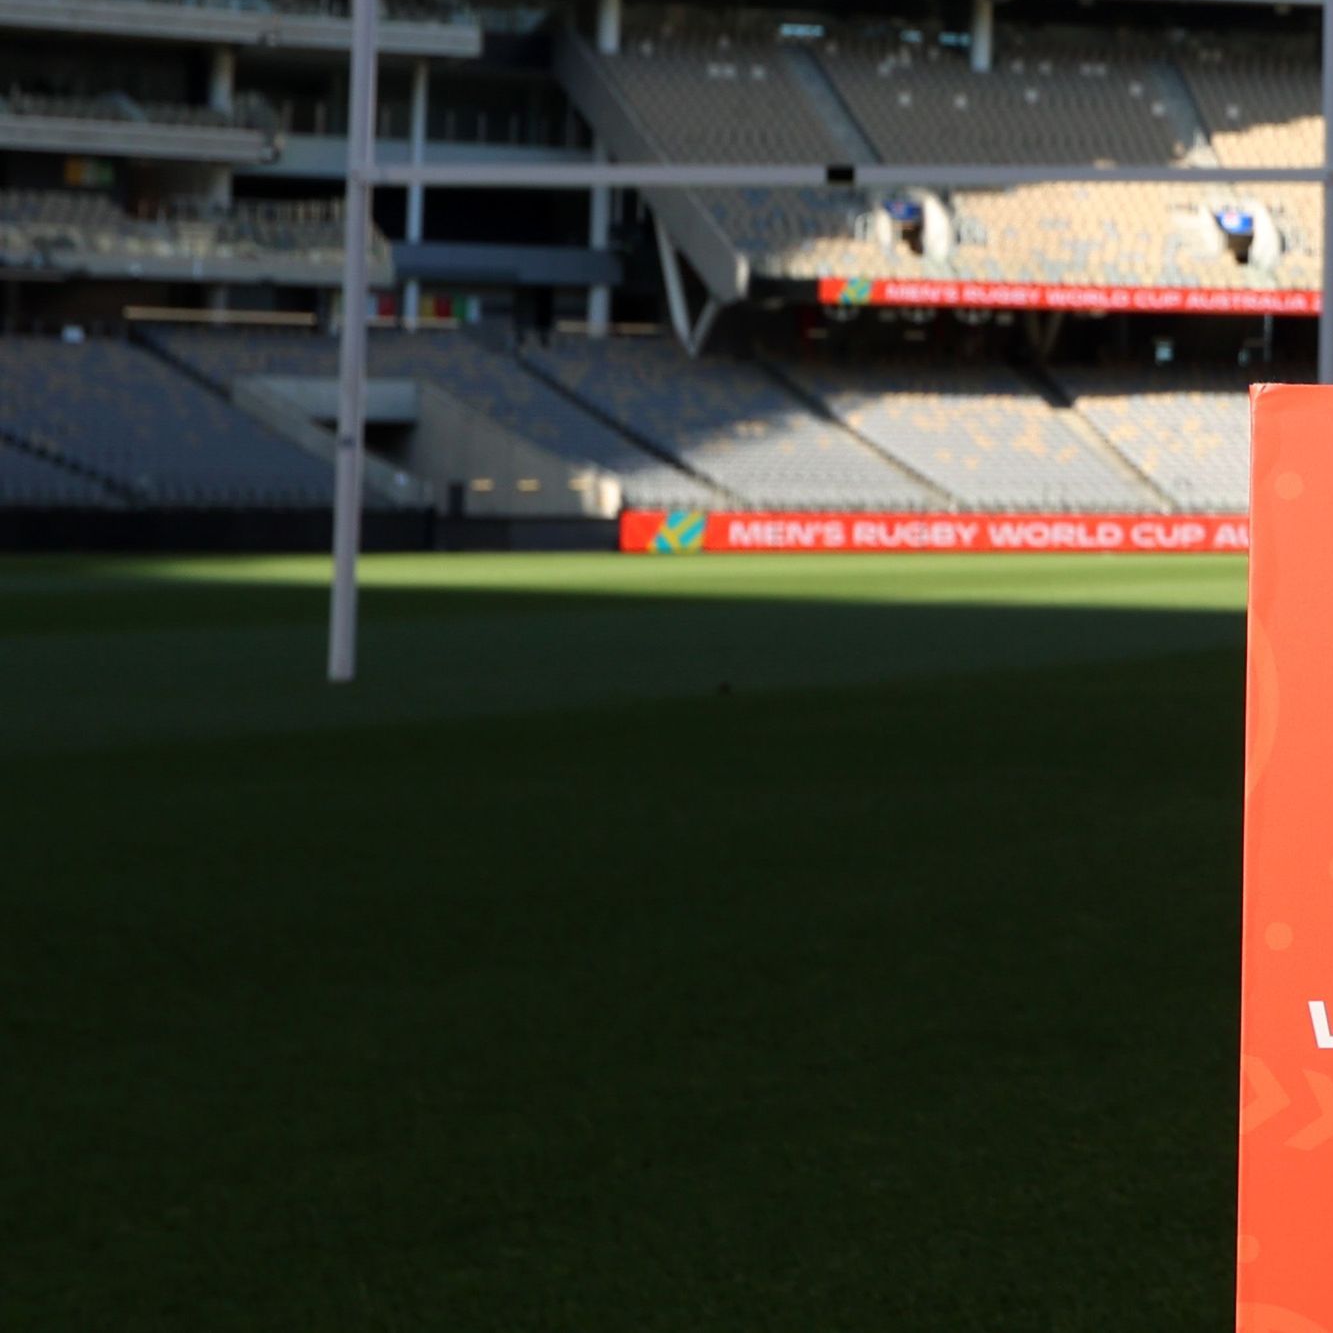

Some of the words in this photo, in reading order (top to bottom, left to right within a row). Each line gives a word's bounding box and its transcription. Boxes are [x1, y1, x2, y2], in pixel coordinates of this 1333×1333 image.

[730, 522, 844, 547] MEN'S
[852, 522, 978, 547] RUGBY
[988, 522, 1123, 548] WORLD
[1131, 523, 1204, 548] CUP
